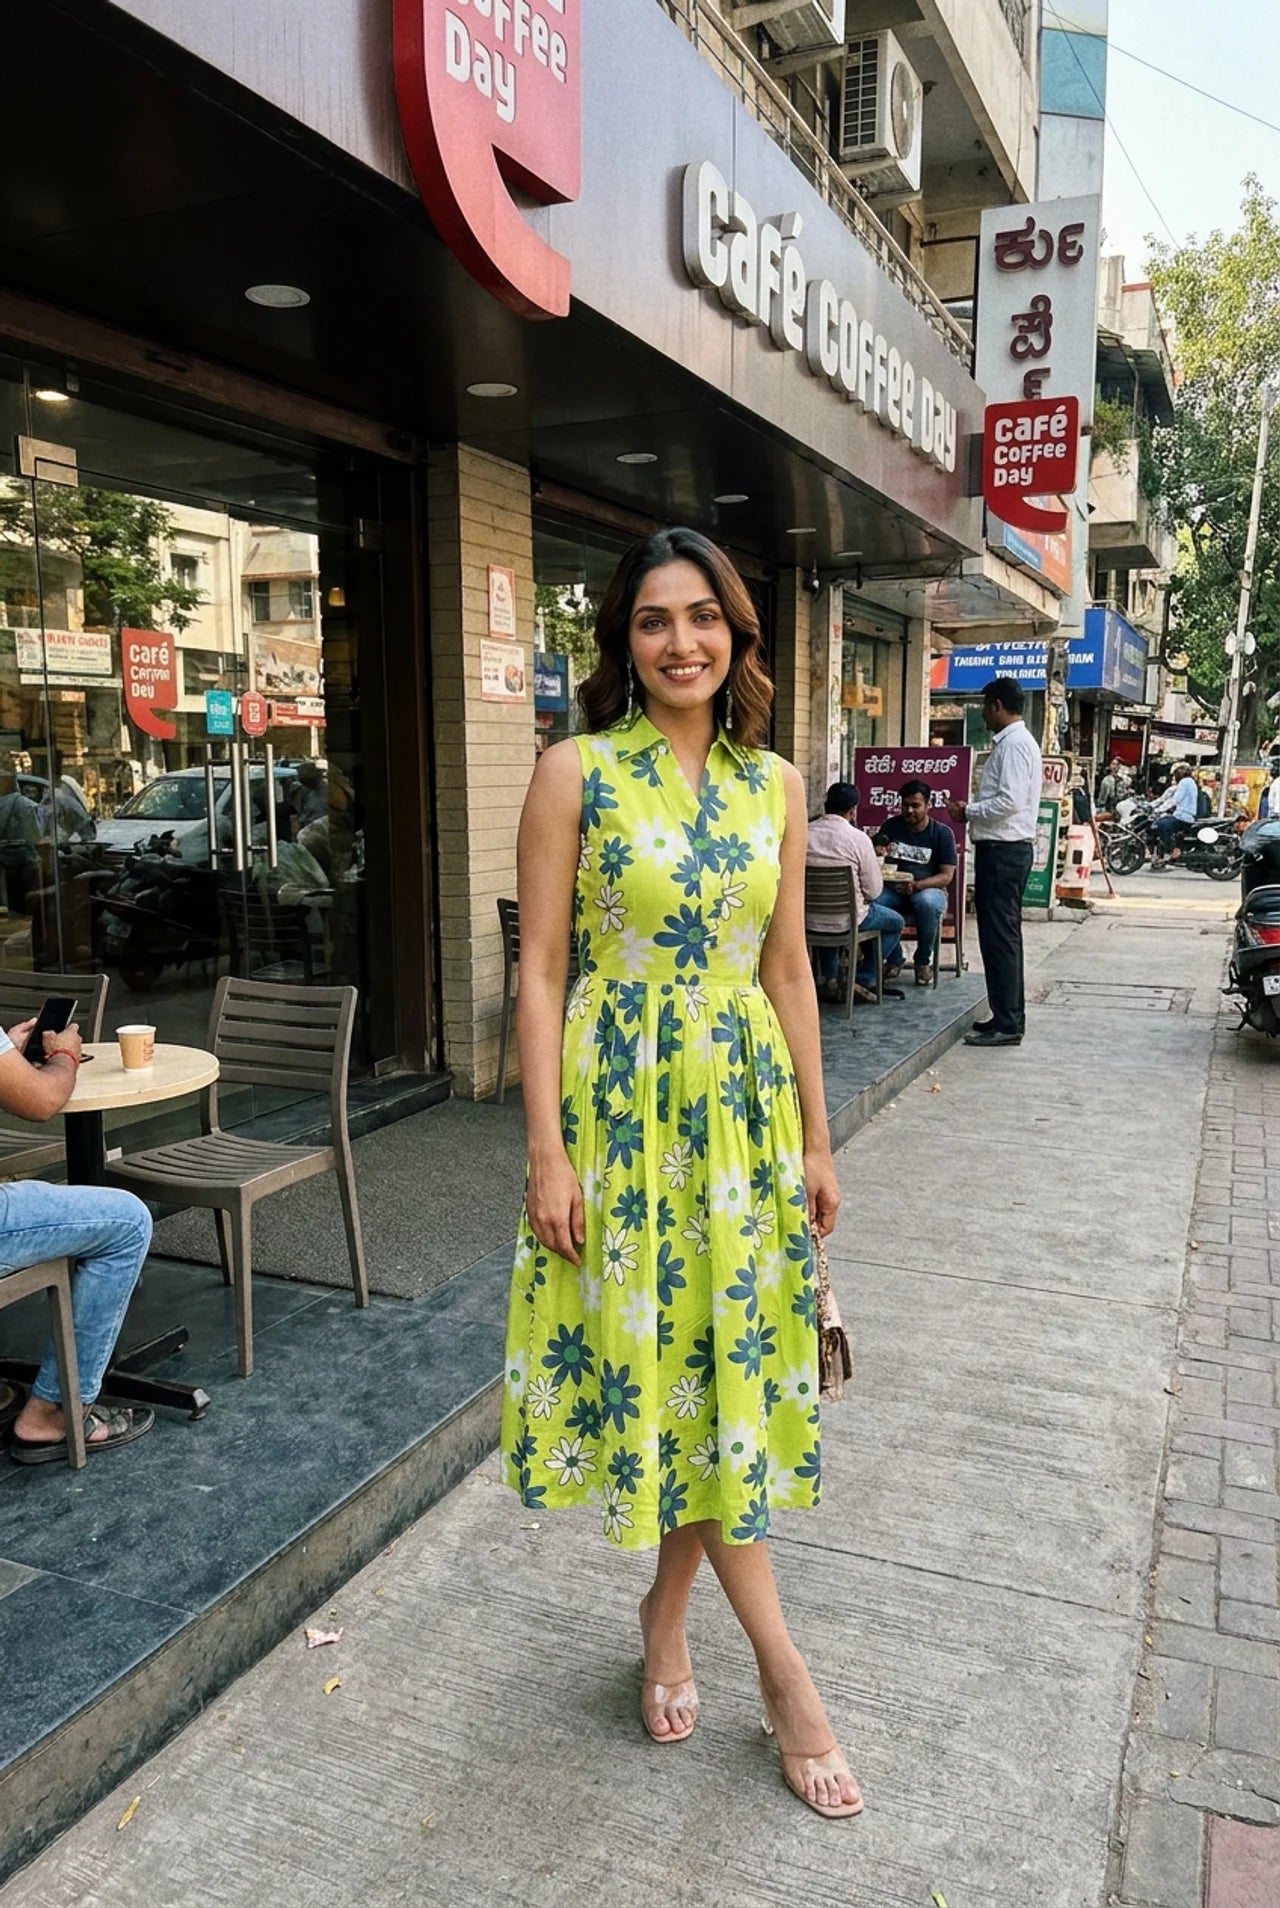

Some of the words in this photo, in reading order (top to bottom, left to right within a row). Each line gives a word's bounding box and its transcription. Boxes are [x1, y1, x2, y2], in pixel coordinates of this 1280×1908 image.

[445, 7, 516, 124] Day
[696, 159, 805, 352] Café
[920, 376, 957, 473] Day
[994, 404, 1069, 443] Café
[994, 442, 1067, 466] Coffee
[993, 466, 1034, 488] Day
[129, 641, 170, 665] Café
